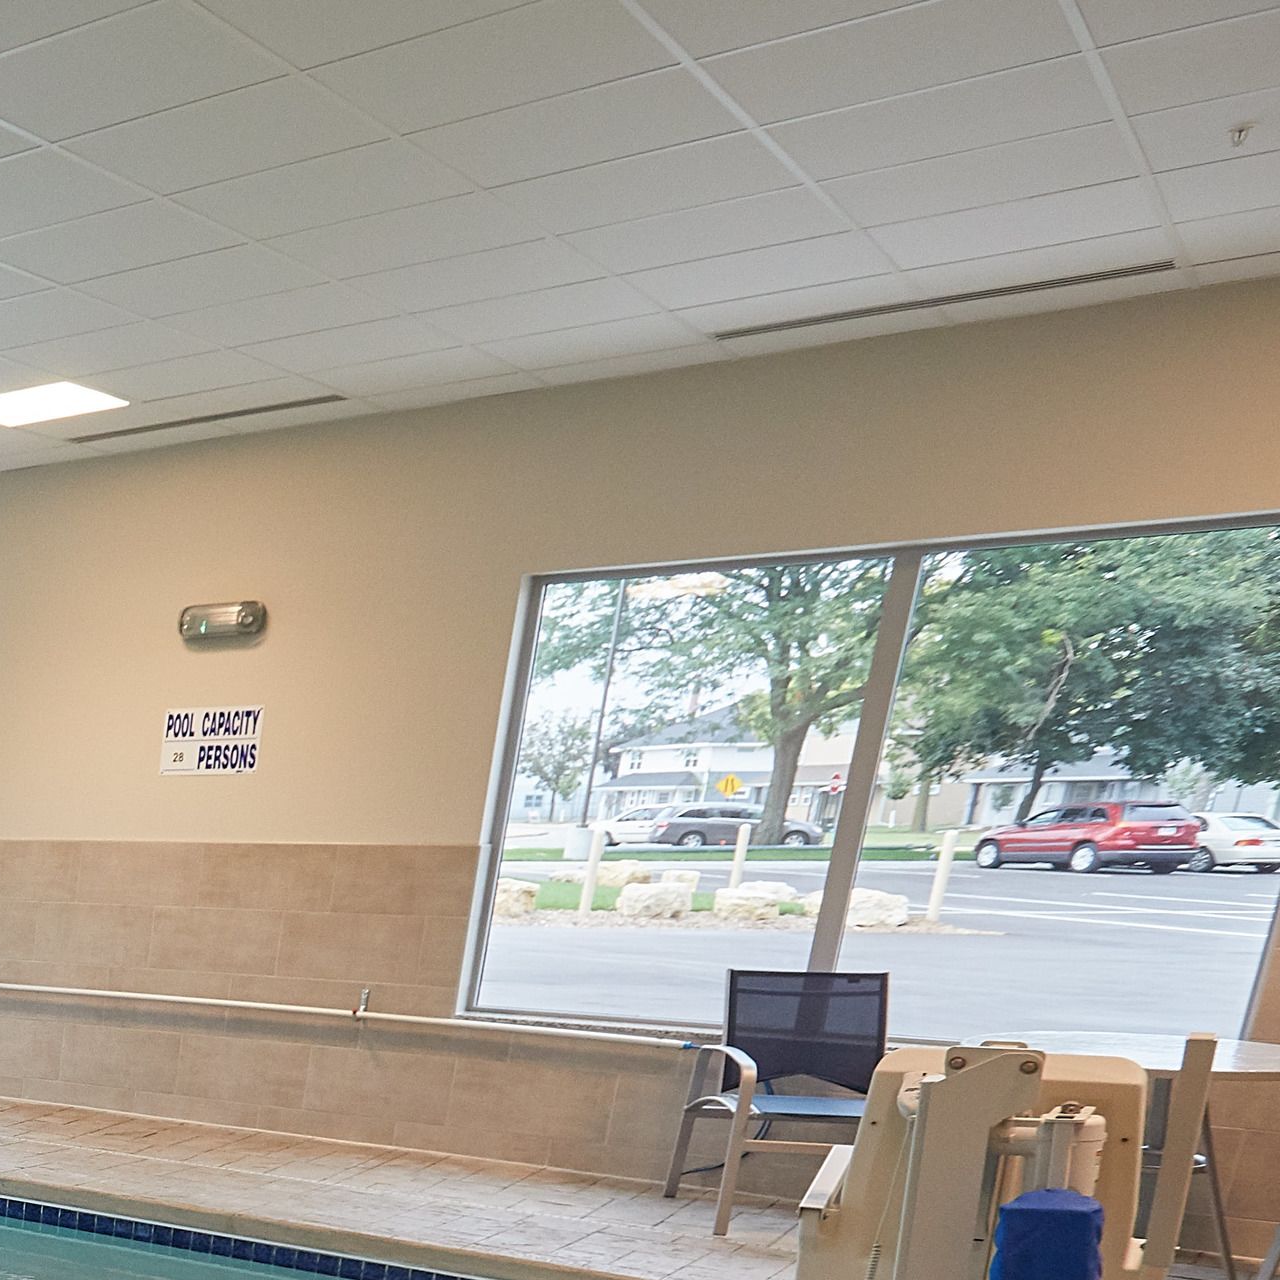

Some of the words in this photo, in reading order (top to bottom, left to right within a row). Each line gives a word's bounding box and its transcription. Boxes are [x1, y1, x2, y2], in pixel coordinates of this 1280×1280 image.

[166, 713, 194, 738] POOL
[202, 710, 260, 736] CAPACITY
[172, 752, 184, 762] 28
[197, 744, 257, 770] PERSONS
